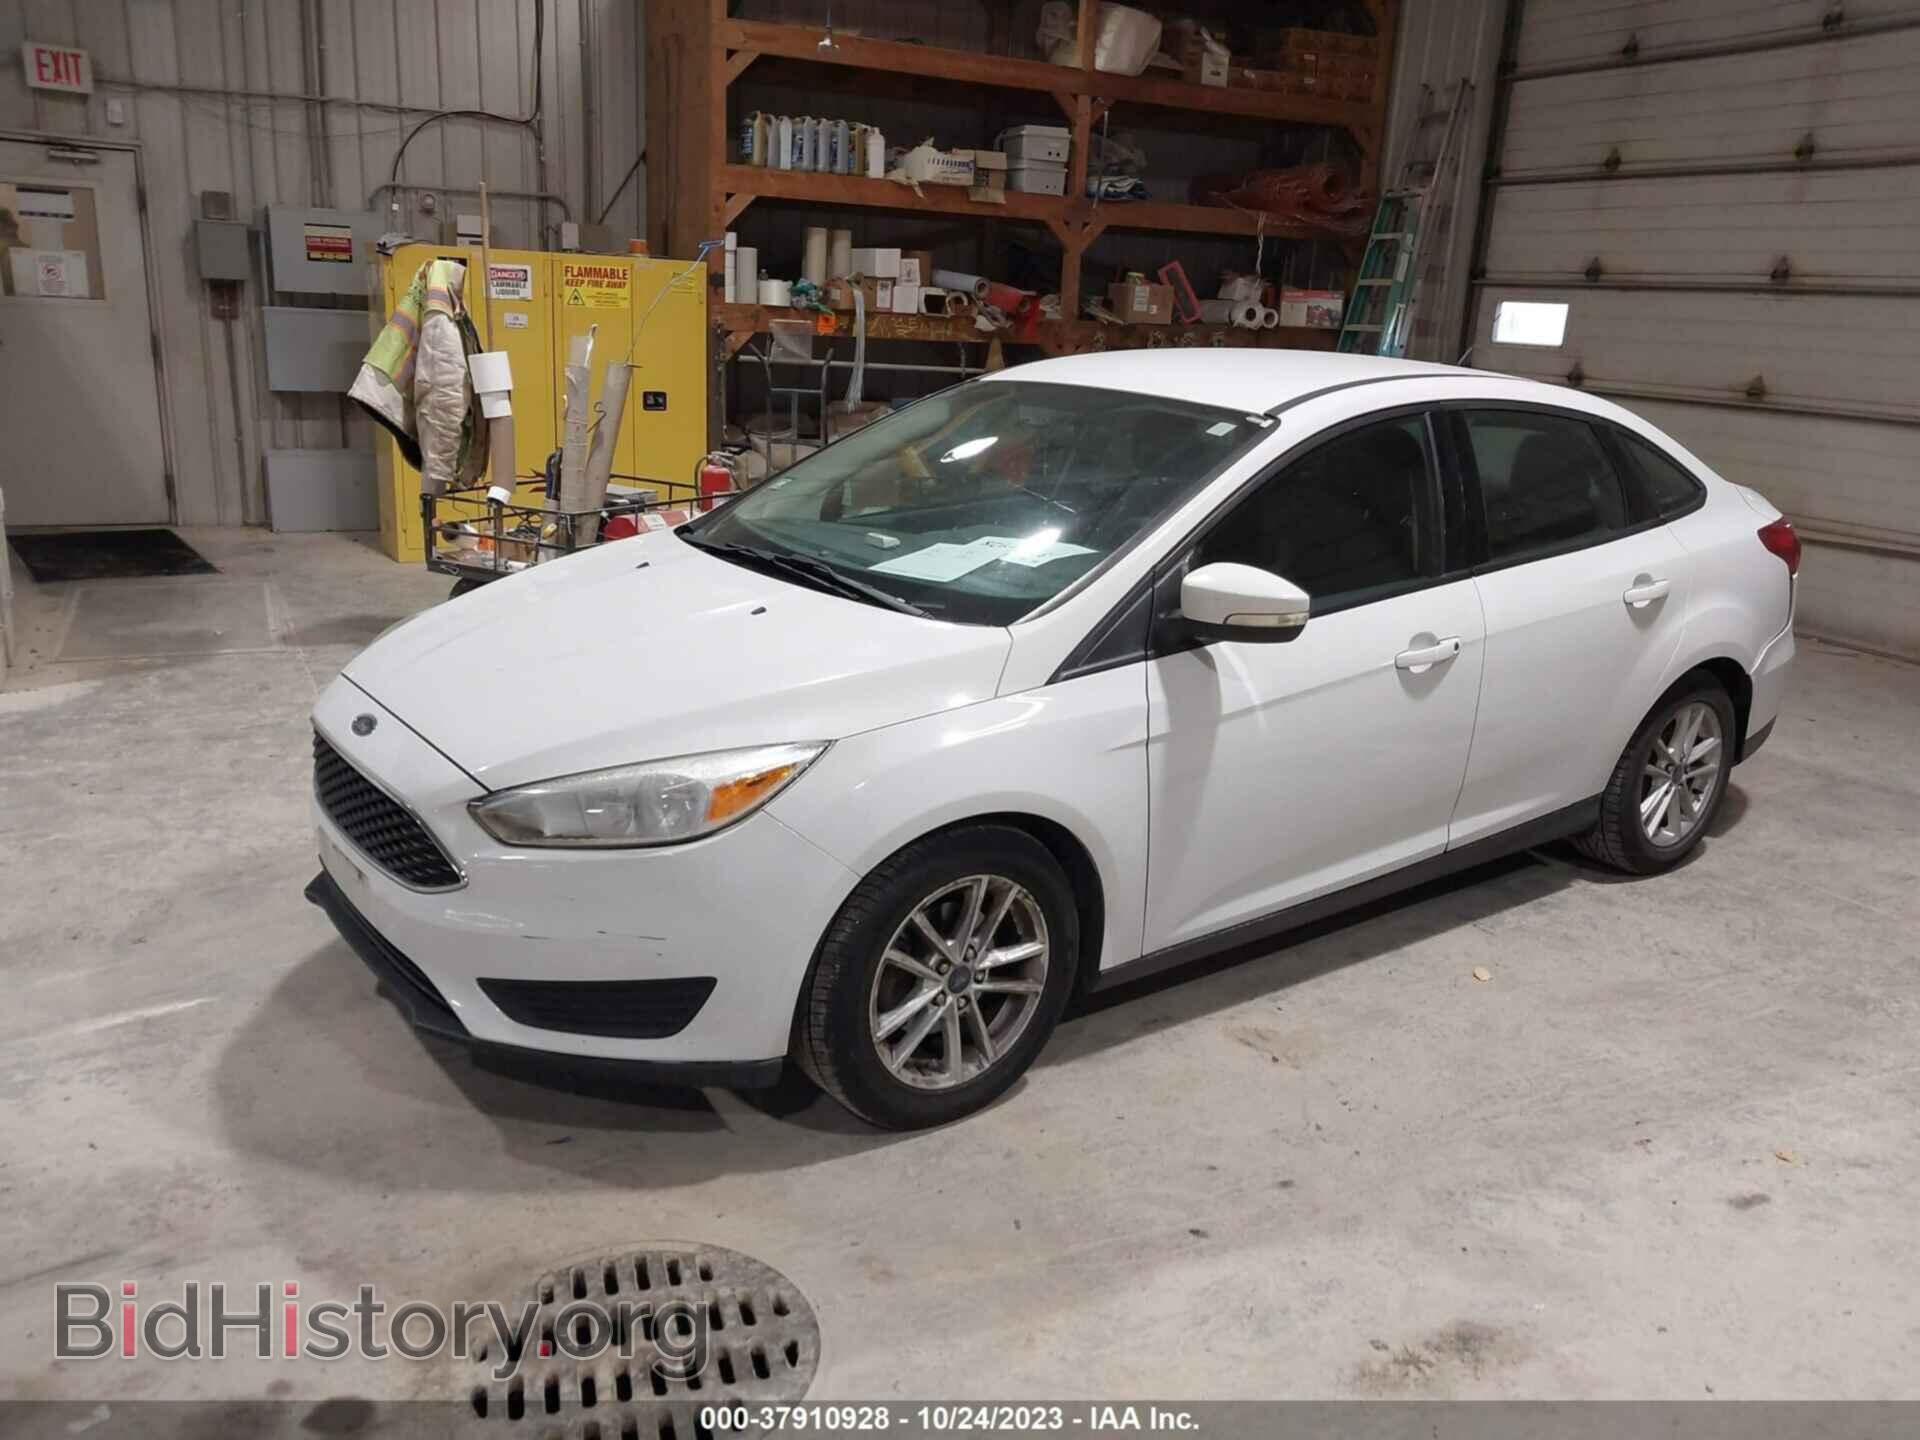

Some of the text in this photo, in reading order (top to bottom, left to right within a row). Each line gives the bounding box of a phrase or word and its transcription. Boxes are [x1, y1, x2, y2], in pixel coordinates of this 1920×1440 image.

[33, 48, 81, 86] EXIT
[565, 265, 629, 280] FLAMMABLE
[565, 279, 627, 289] KEEP FIRE AWAY
